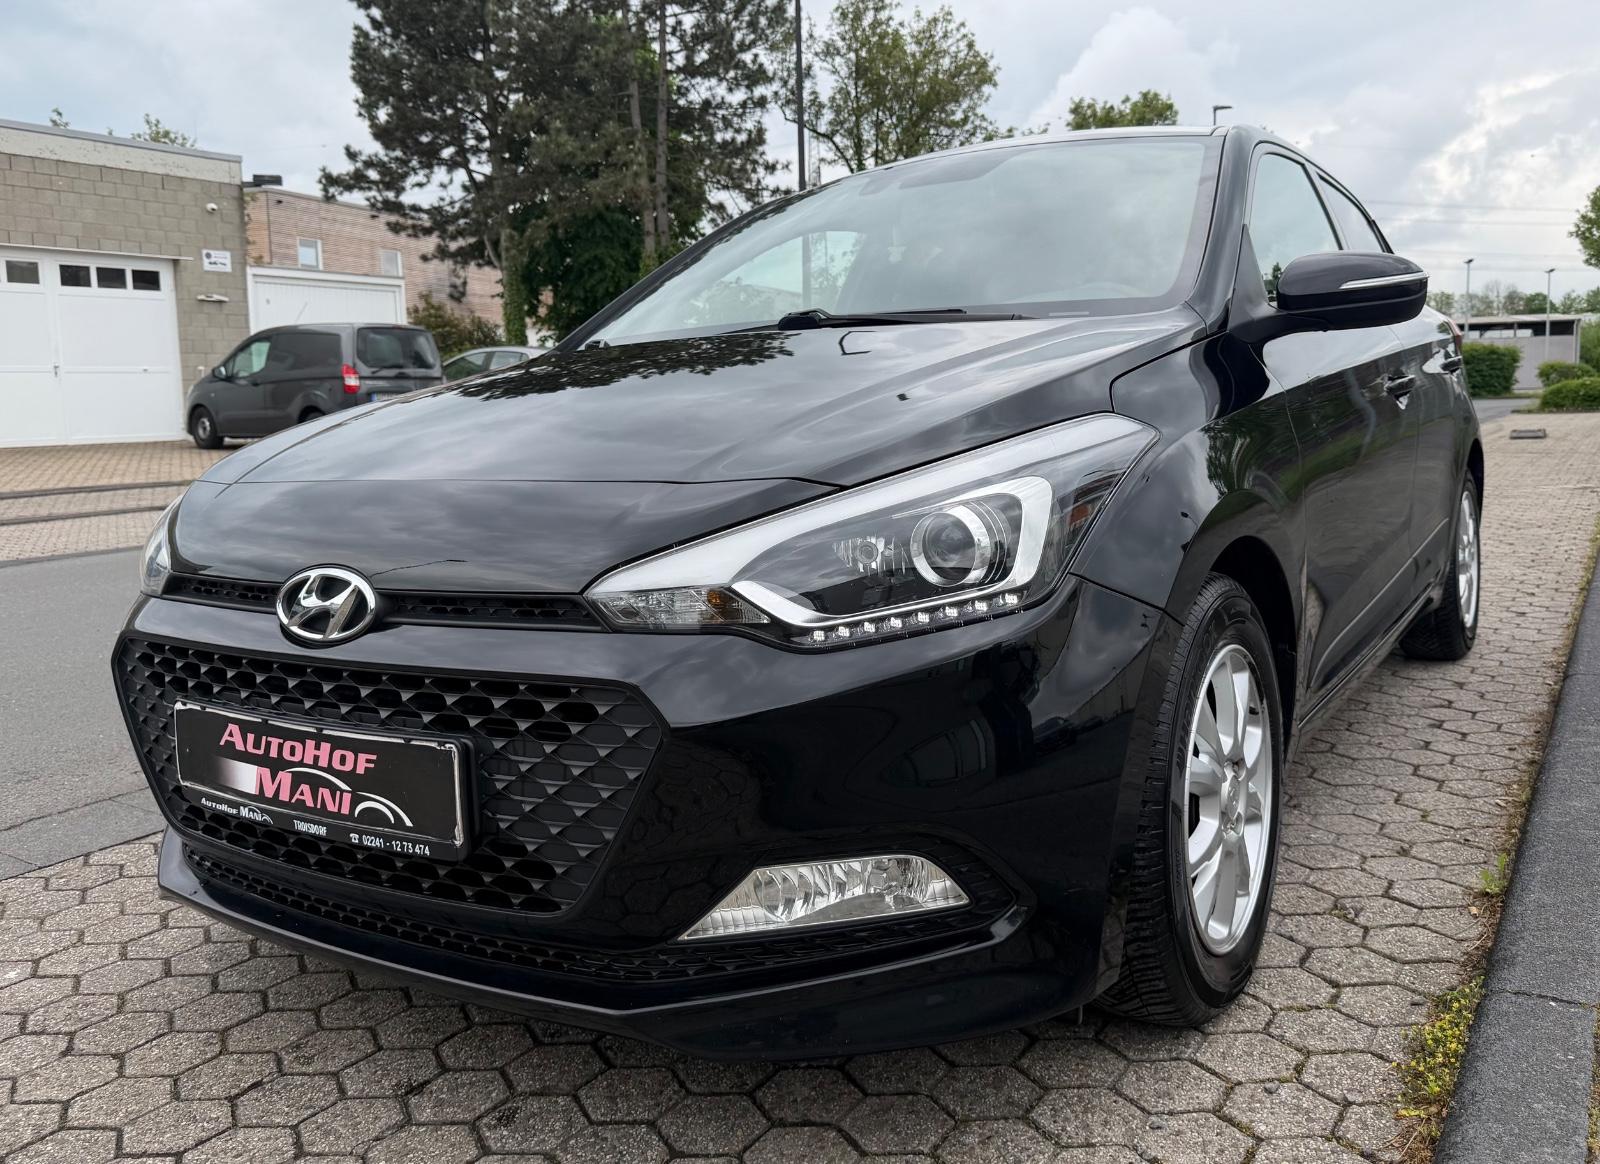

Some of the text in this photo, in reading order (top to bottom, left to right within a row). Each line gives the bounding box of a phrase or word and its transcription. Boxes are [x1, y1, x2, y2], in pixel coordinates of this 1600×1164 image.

[255, 766, 352, 815] MANI
[293, 819, 327, 836] TROISDORF
[362, 834, 385, 848] 02241
[392, 840, 402, 852] 12
[403, 841, 414, 853] 73
[415, 844, 430, 856] 474
